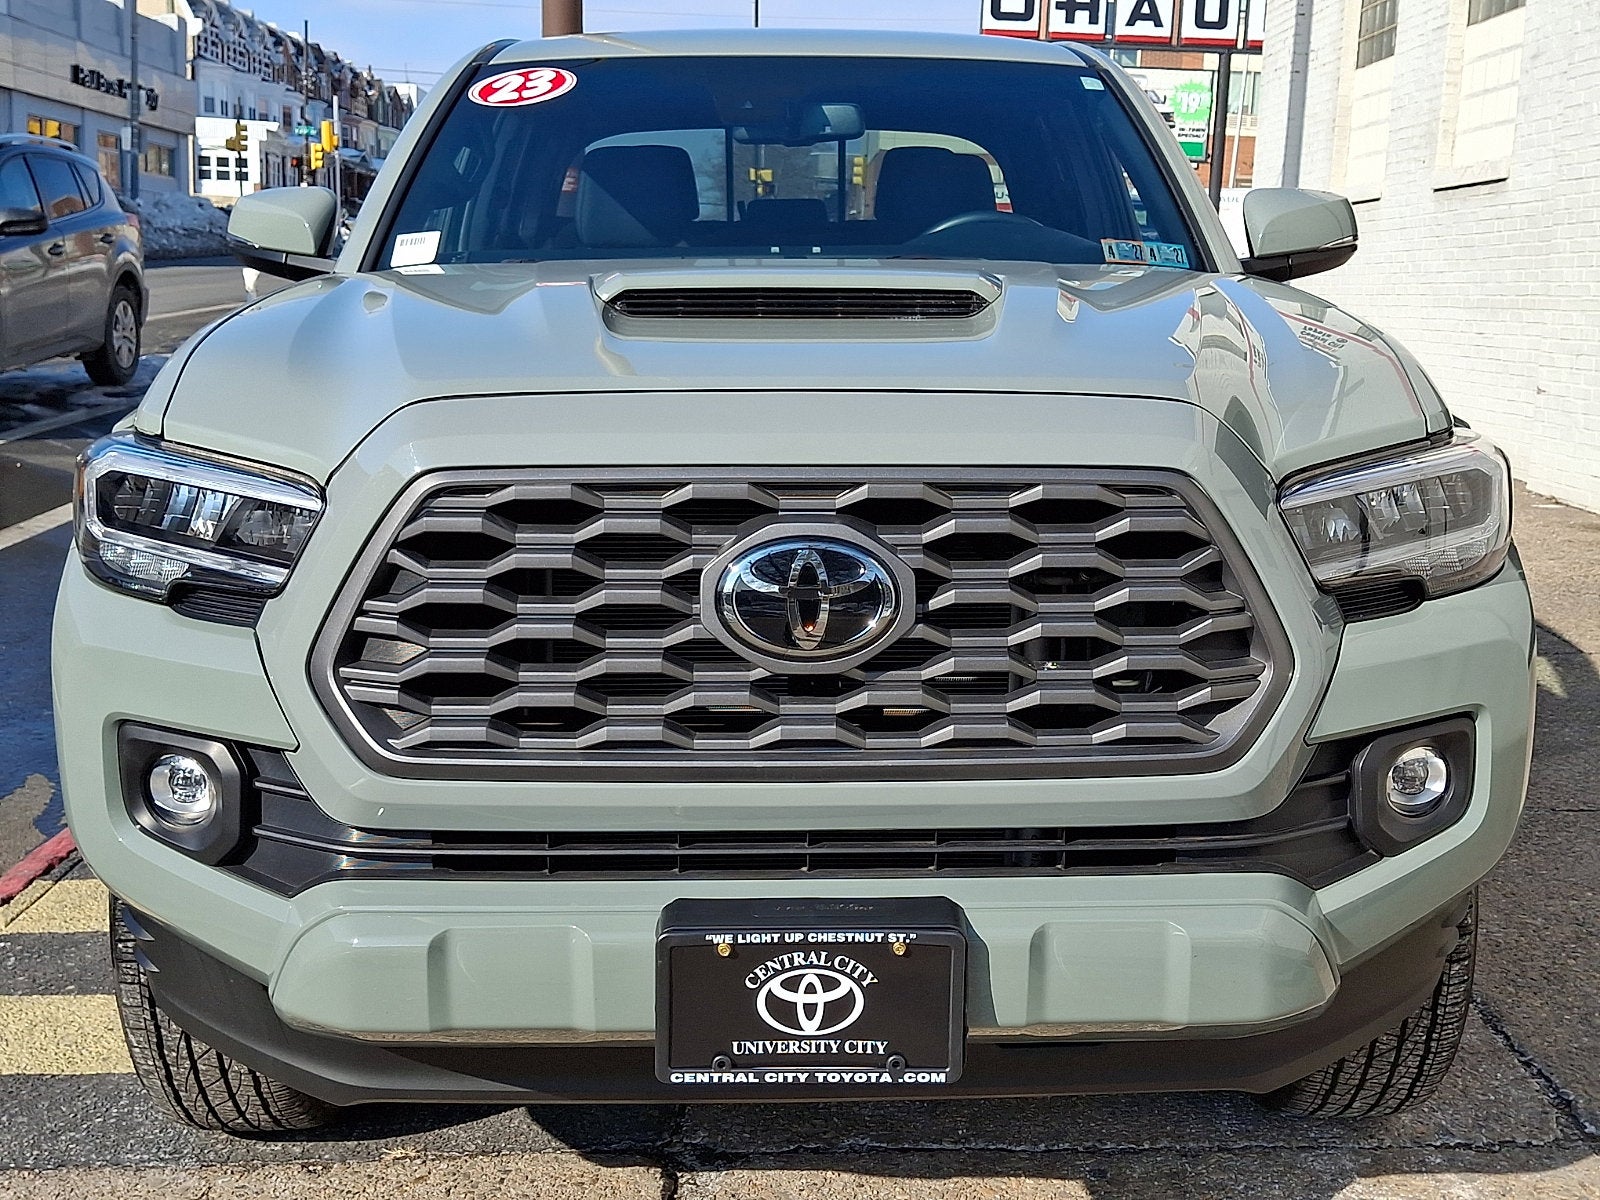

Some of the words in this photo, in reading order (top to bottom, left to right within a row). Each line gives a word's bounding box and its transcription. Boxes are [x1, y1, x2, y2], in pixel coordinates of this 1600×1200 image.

[486, 69, 557, 103] 23
[737, 933, 781, 944] LIGHT
[784, 932, 805, 943] UP
[807, 932, 885, 943] CHESTNUT
[744, 950, 832, 990] CENTRAL
[833, 955, 879, 988] CITY
[731, 1039, 841, 1055] UNIVERSITY
[844, 1039, 888, 1055] CITY
[669, 1072, 759, 1084] CENTRAL
[764, 1072, 810, 1083] CITY
[815, 1072, 893, 1083] TOYOTA
[898, 1072, 946, 1083] .COM
